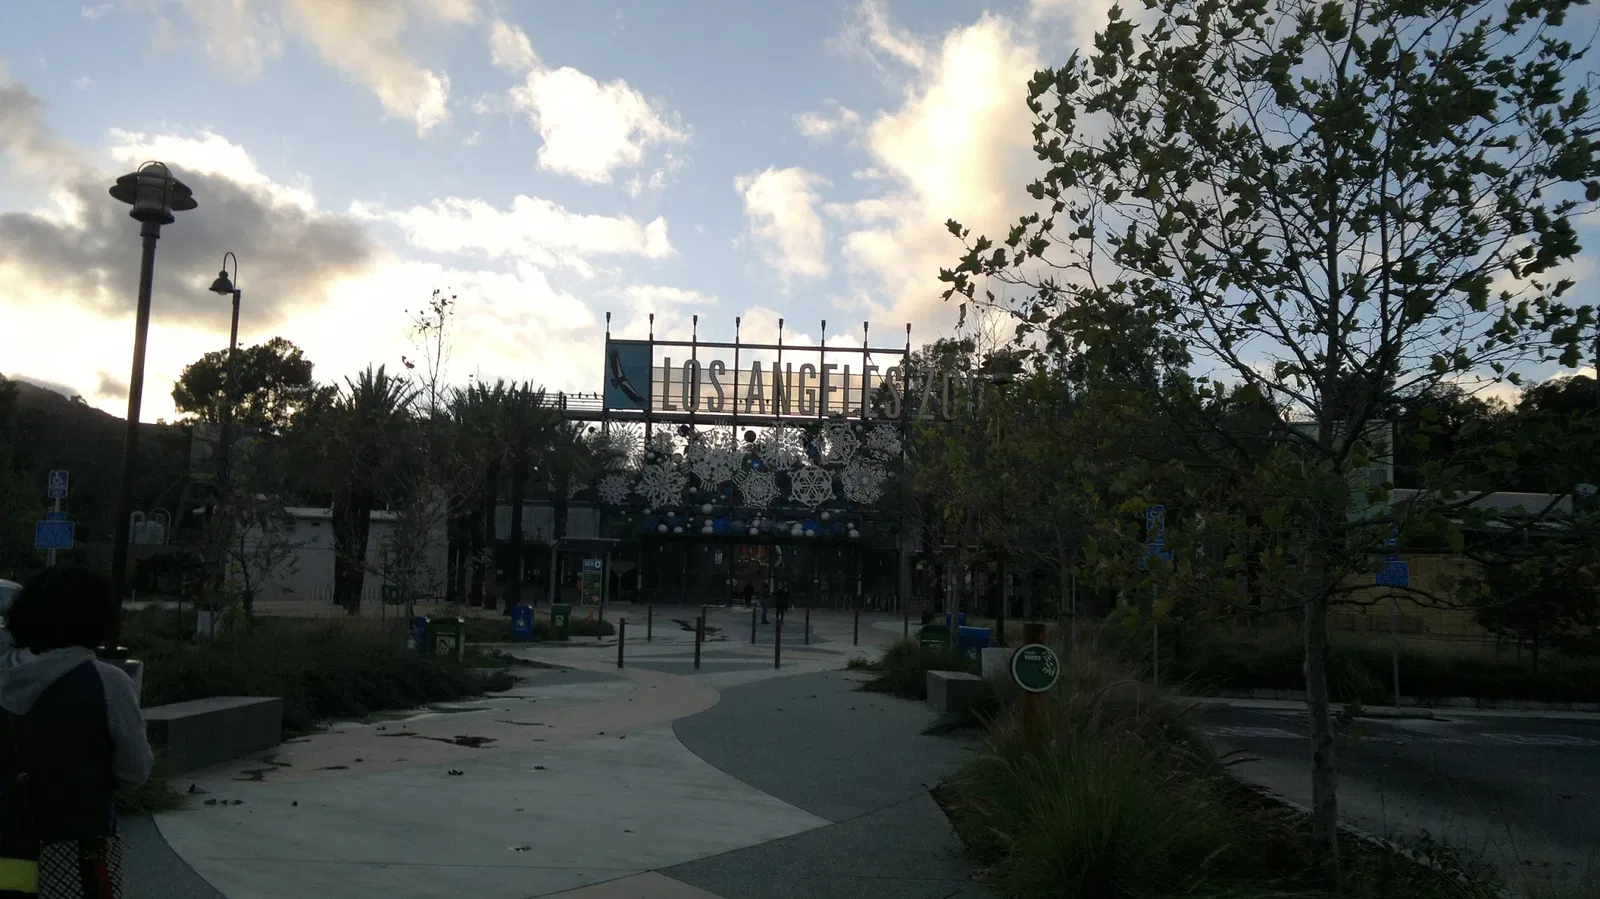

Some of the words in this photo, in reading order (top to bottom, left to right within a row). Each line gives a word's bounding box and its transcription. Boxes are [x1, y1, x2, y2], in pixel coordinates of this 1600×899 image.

[662, 357, 726, 413] LOS
[745, 360, 902, 419] ANGELES
[919, 367, 986, 423] ZO
